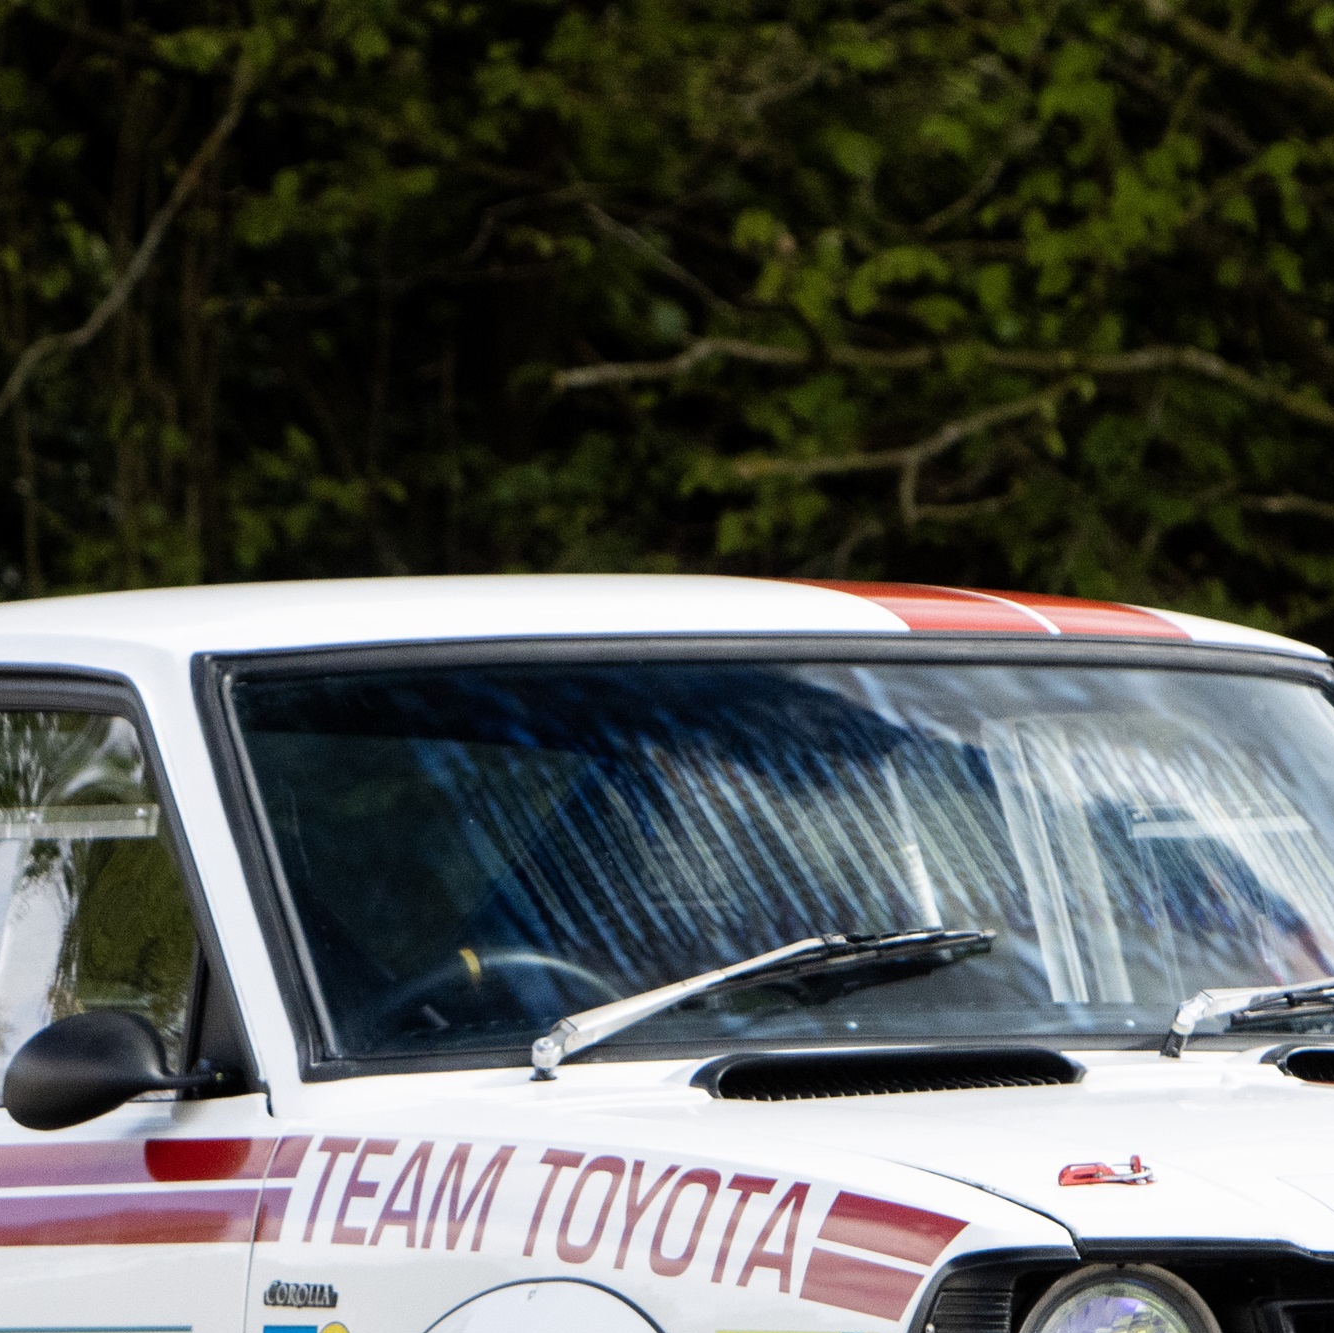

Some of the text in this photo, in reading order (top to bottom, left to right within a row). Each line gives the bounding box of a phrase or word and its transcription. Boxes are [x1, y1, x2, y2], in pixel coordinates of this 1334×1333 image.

[302, 1136, 811, 1294] TEAM TOYOTA
[265, 1280, 337, 1307] COROLLA
